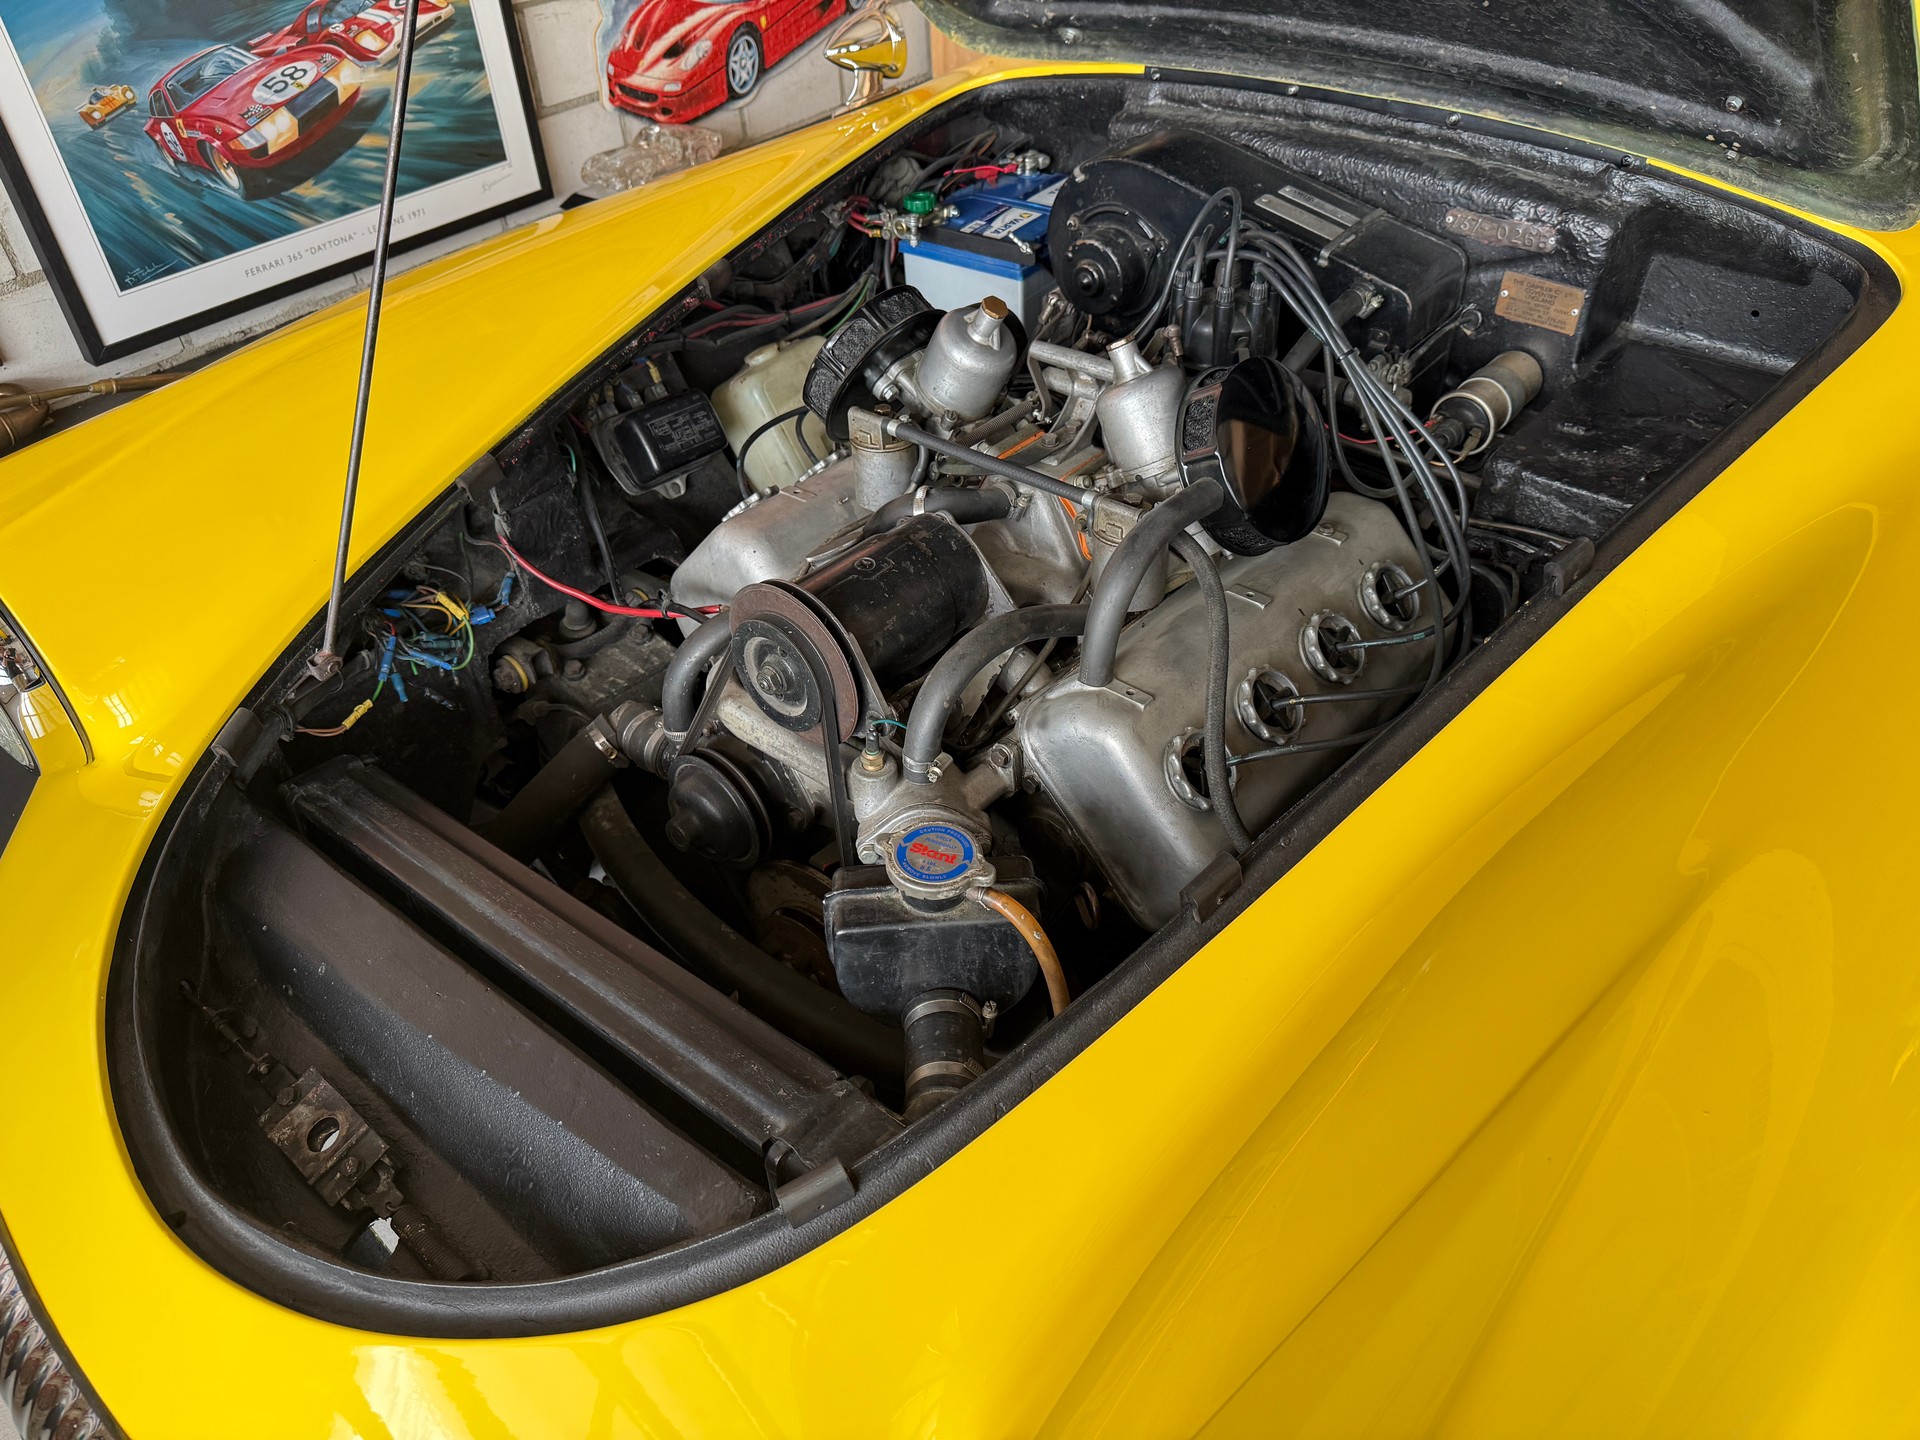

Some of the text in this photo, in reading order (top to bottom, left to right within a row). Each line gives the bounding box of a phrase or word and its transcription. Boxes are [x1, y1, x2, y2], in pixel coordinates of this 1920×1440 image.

[261, 65, 308, 94] 58
[990, 218, 1024, 235] VARTA
[244, 258, 285, 278] FERRARI
[287, 251, 303, 263] 365
[304, 231, 357, 256] "DAYTONA"
[367, 225, 378, 235] LE
[408, 208, 426, 221] 1971
[1525, 288, 1558, 301] COVENTRY
[947, 829, 970, 848] PRESSURE
[910, 842, 957, 864] Stant
